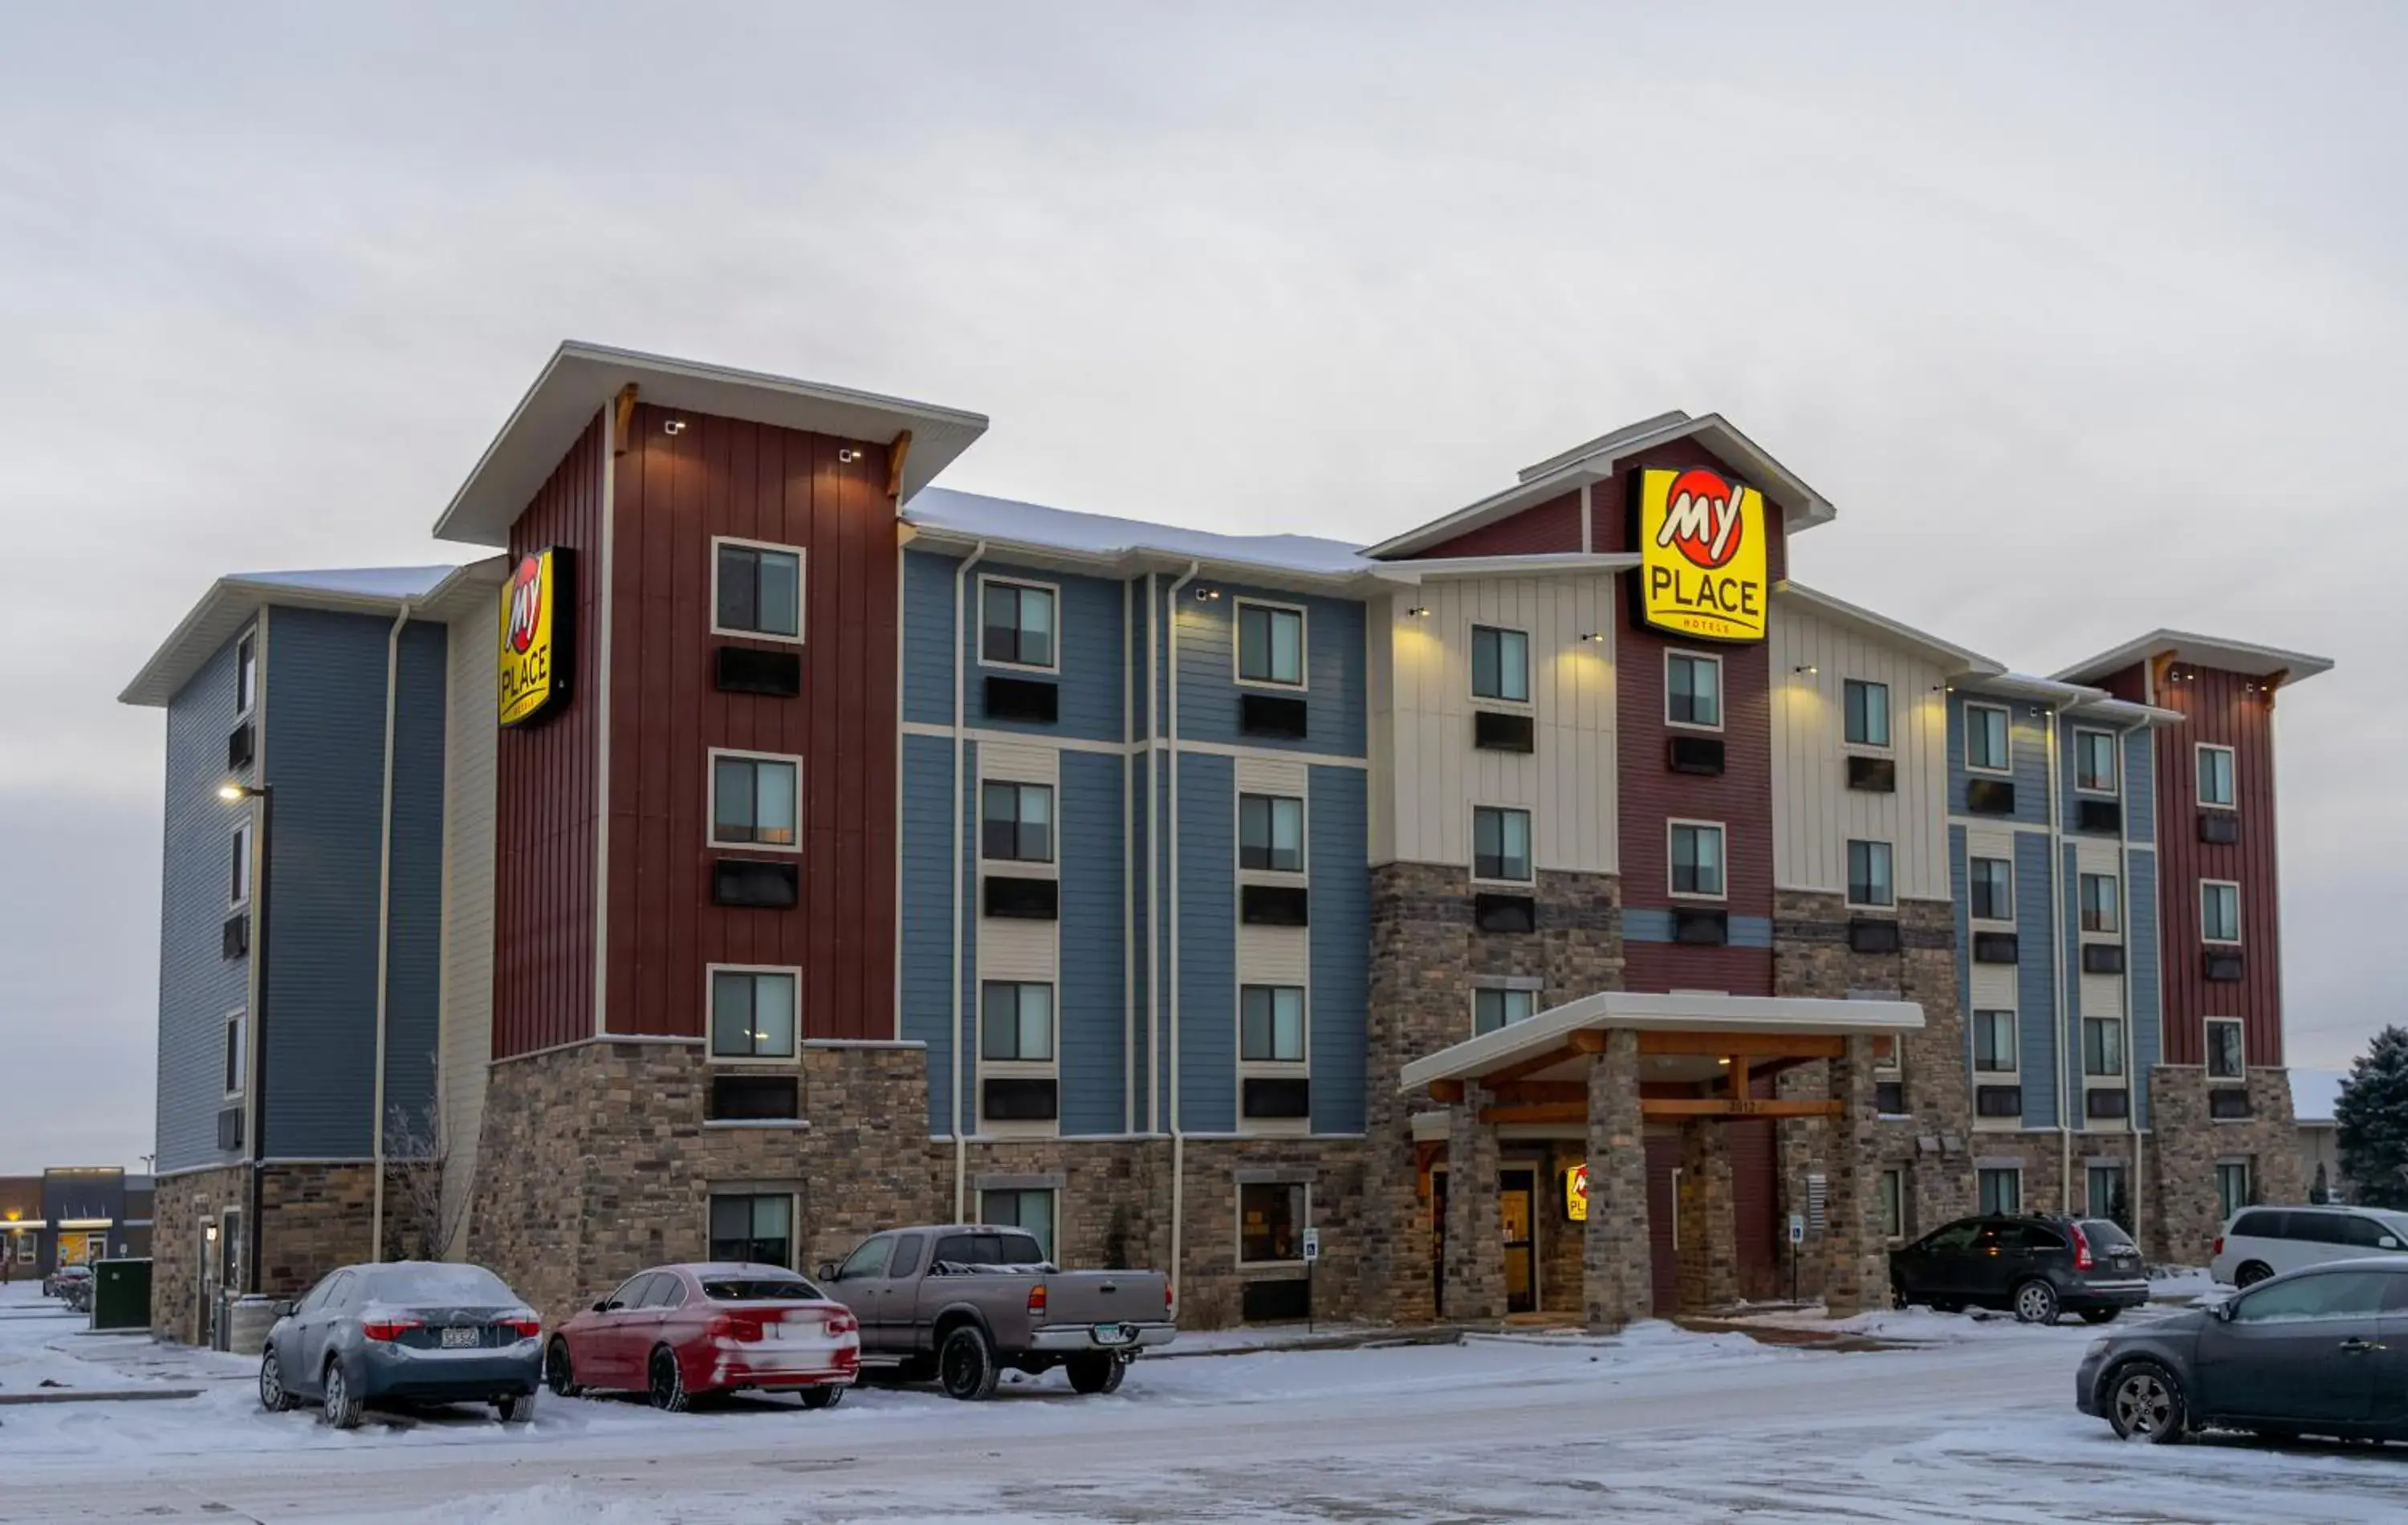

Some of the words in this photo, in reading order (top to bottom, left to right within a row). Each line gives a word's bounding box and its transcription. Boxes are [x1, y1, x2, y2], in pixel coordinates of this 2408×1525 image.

[1651, 565, 1759, 616] PLACE
[1683, 619, 1730, 634] HOTELS
[502, 645, 547, 703] PLACE
